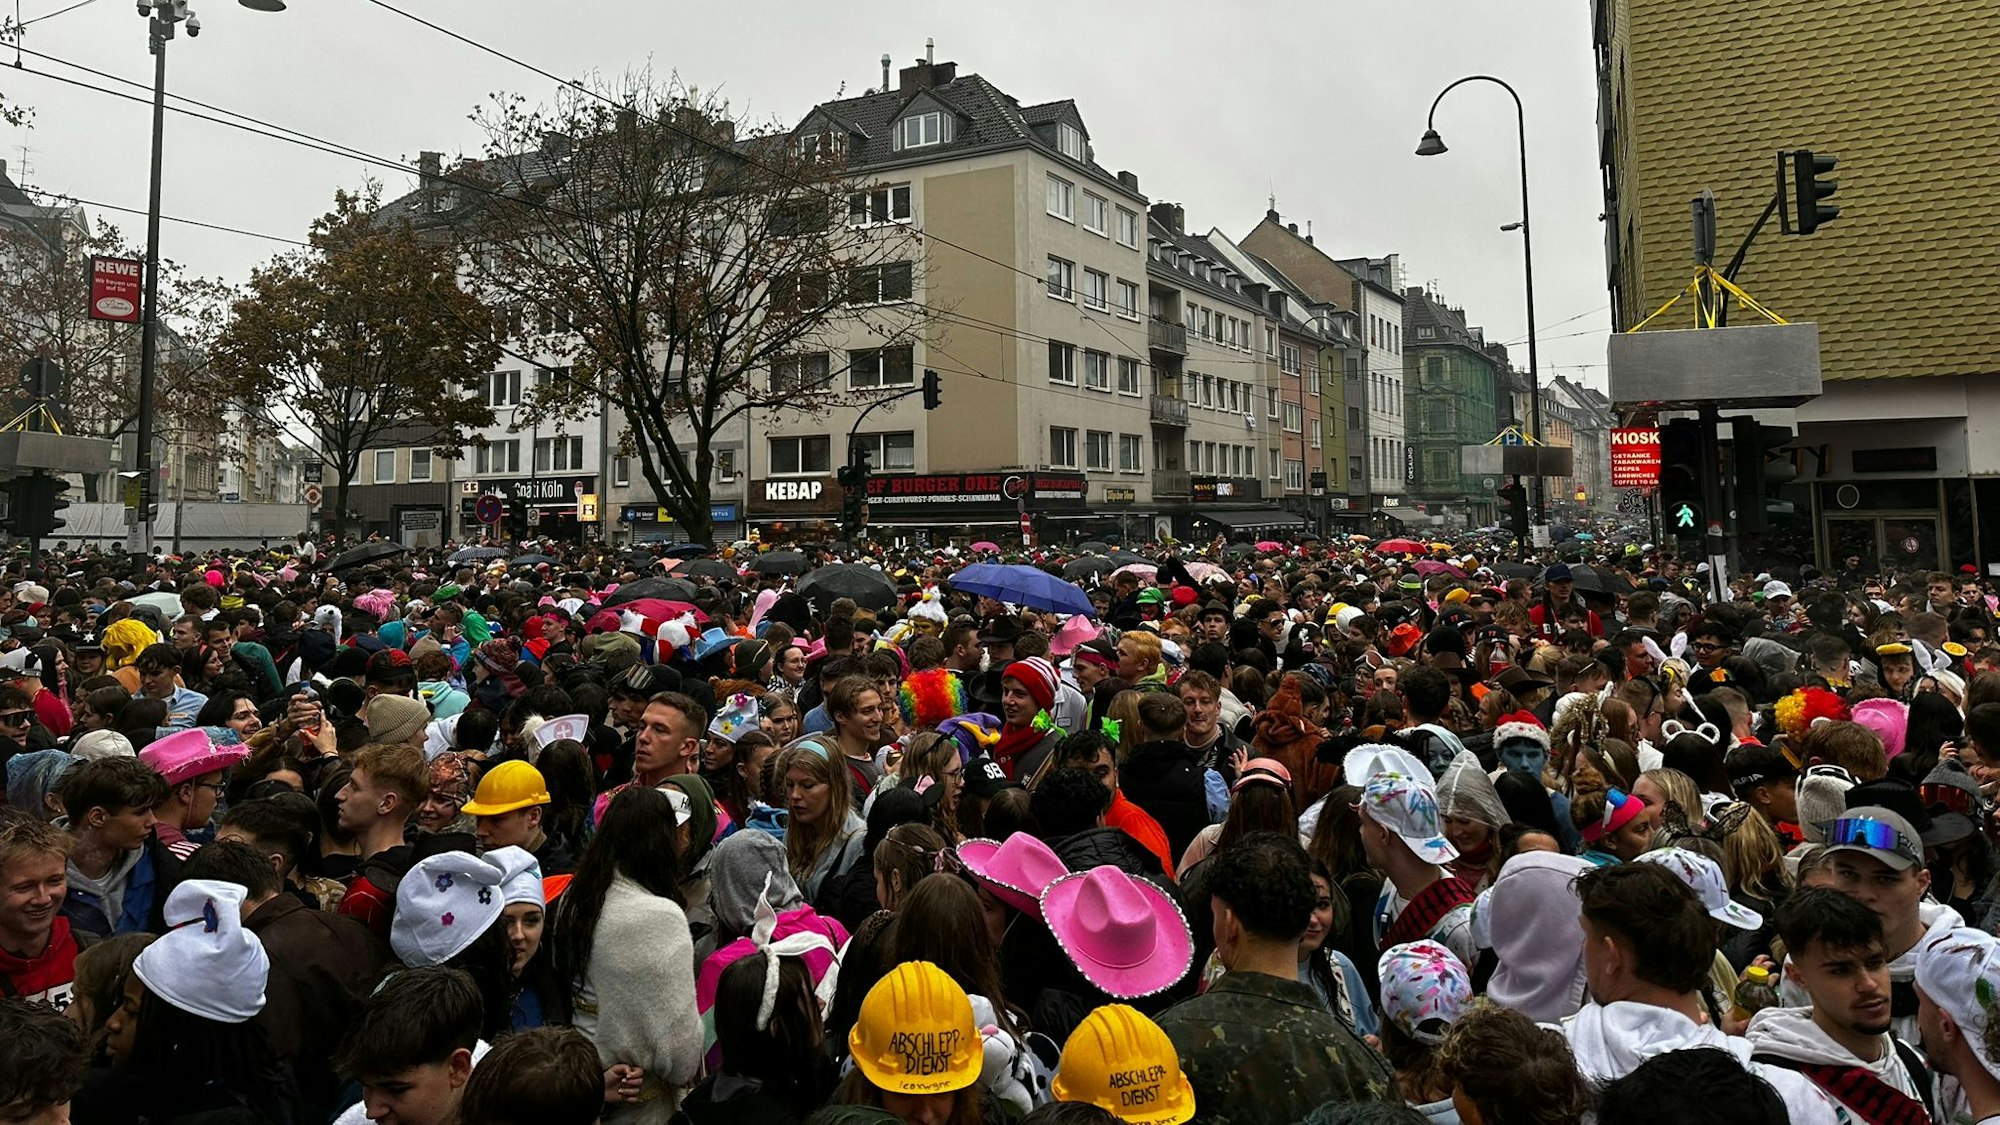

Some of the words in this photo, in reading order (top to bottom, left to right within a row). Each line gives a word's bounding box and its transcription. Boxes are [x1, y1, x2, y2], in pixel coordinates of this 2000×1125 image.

[95, 260, 138, 277] REWE
[1611, 431, 1661, 445] KIOSK
[541, 480, 564, 498] Köln
[765, 481, 823, 500] KEBAP
[891, 476, 960, 494] BURGER
[965, 475, 1000, 492] ONE
[905, 1052, 953, 1076] DIENST
[1121, 1084, 1161, 1107] DIENST
